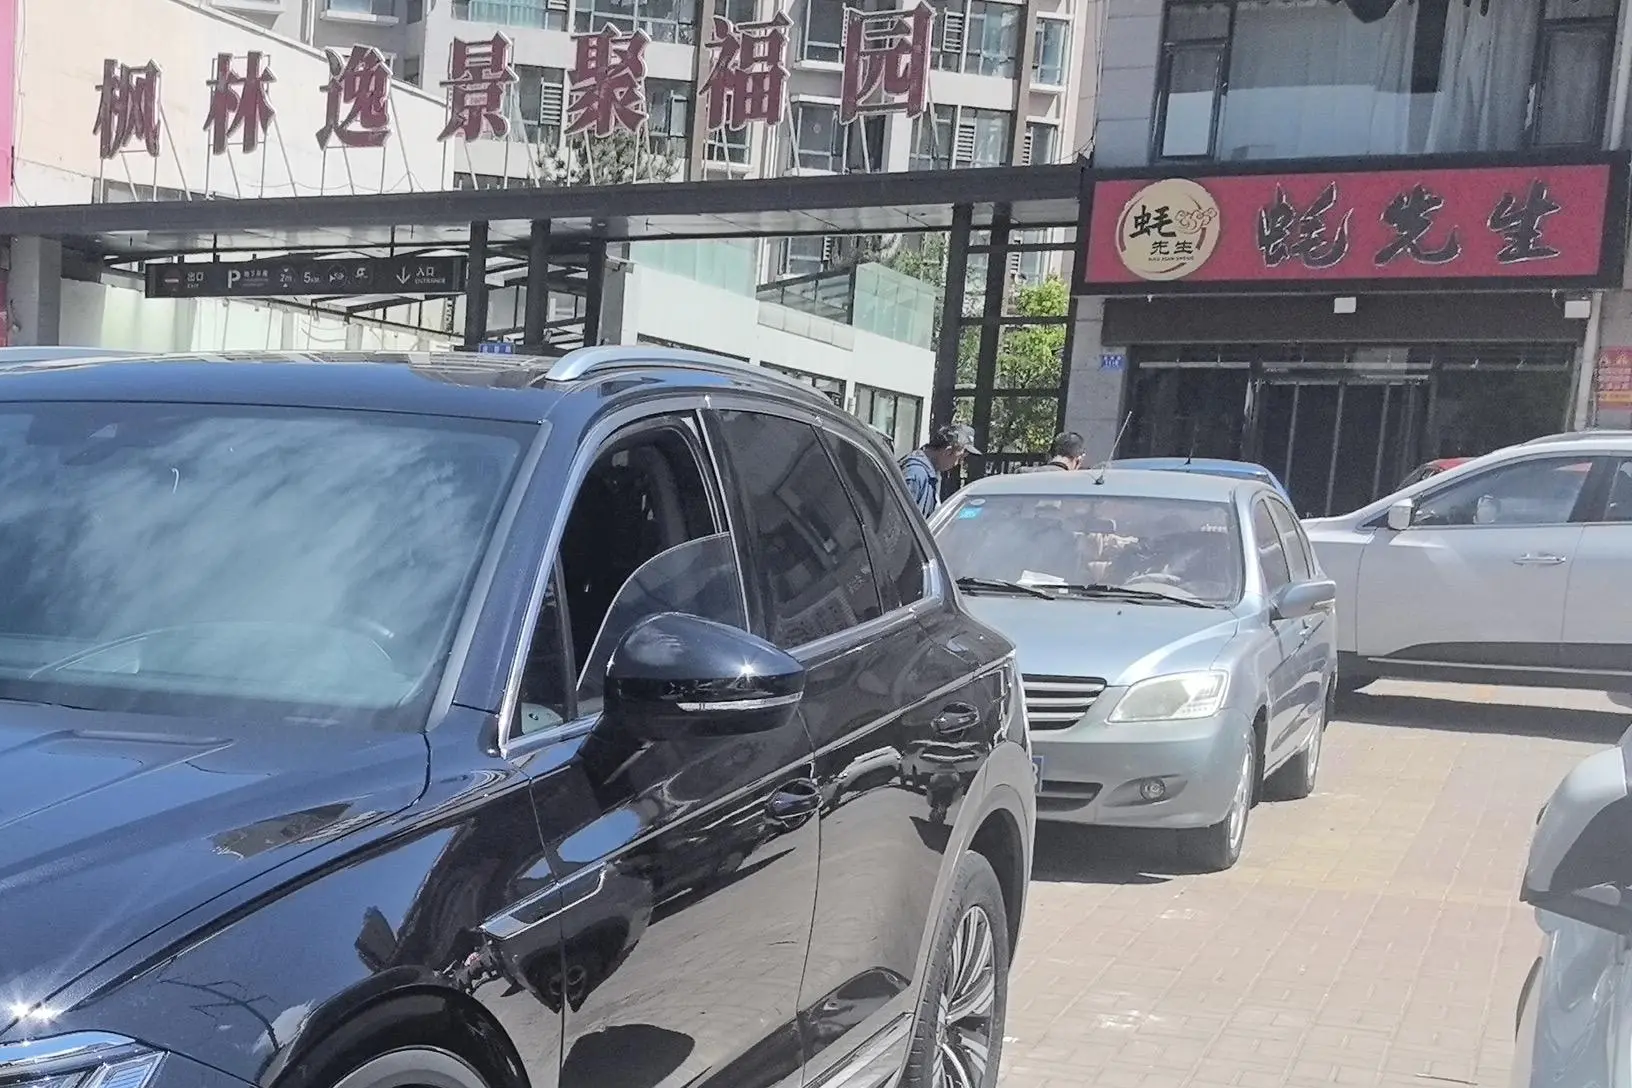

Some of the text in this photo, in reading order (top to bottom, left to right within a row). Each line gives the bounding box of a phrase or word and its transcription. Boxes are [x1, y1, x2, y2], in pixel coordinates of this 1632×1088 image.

[94, 1, 936, 159] 枫林逸景聚福园
[1150, 240, 1195, 256] 先生
[186, 270, 204, 282] 出口
[416, 266, 435, 277] 入口
